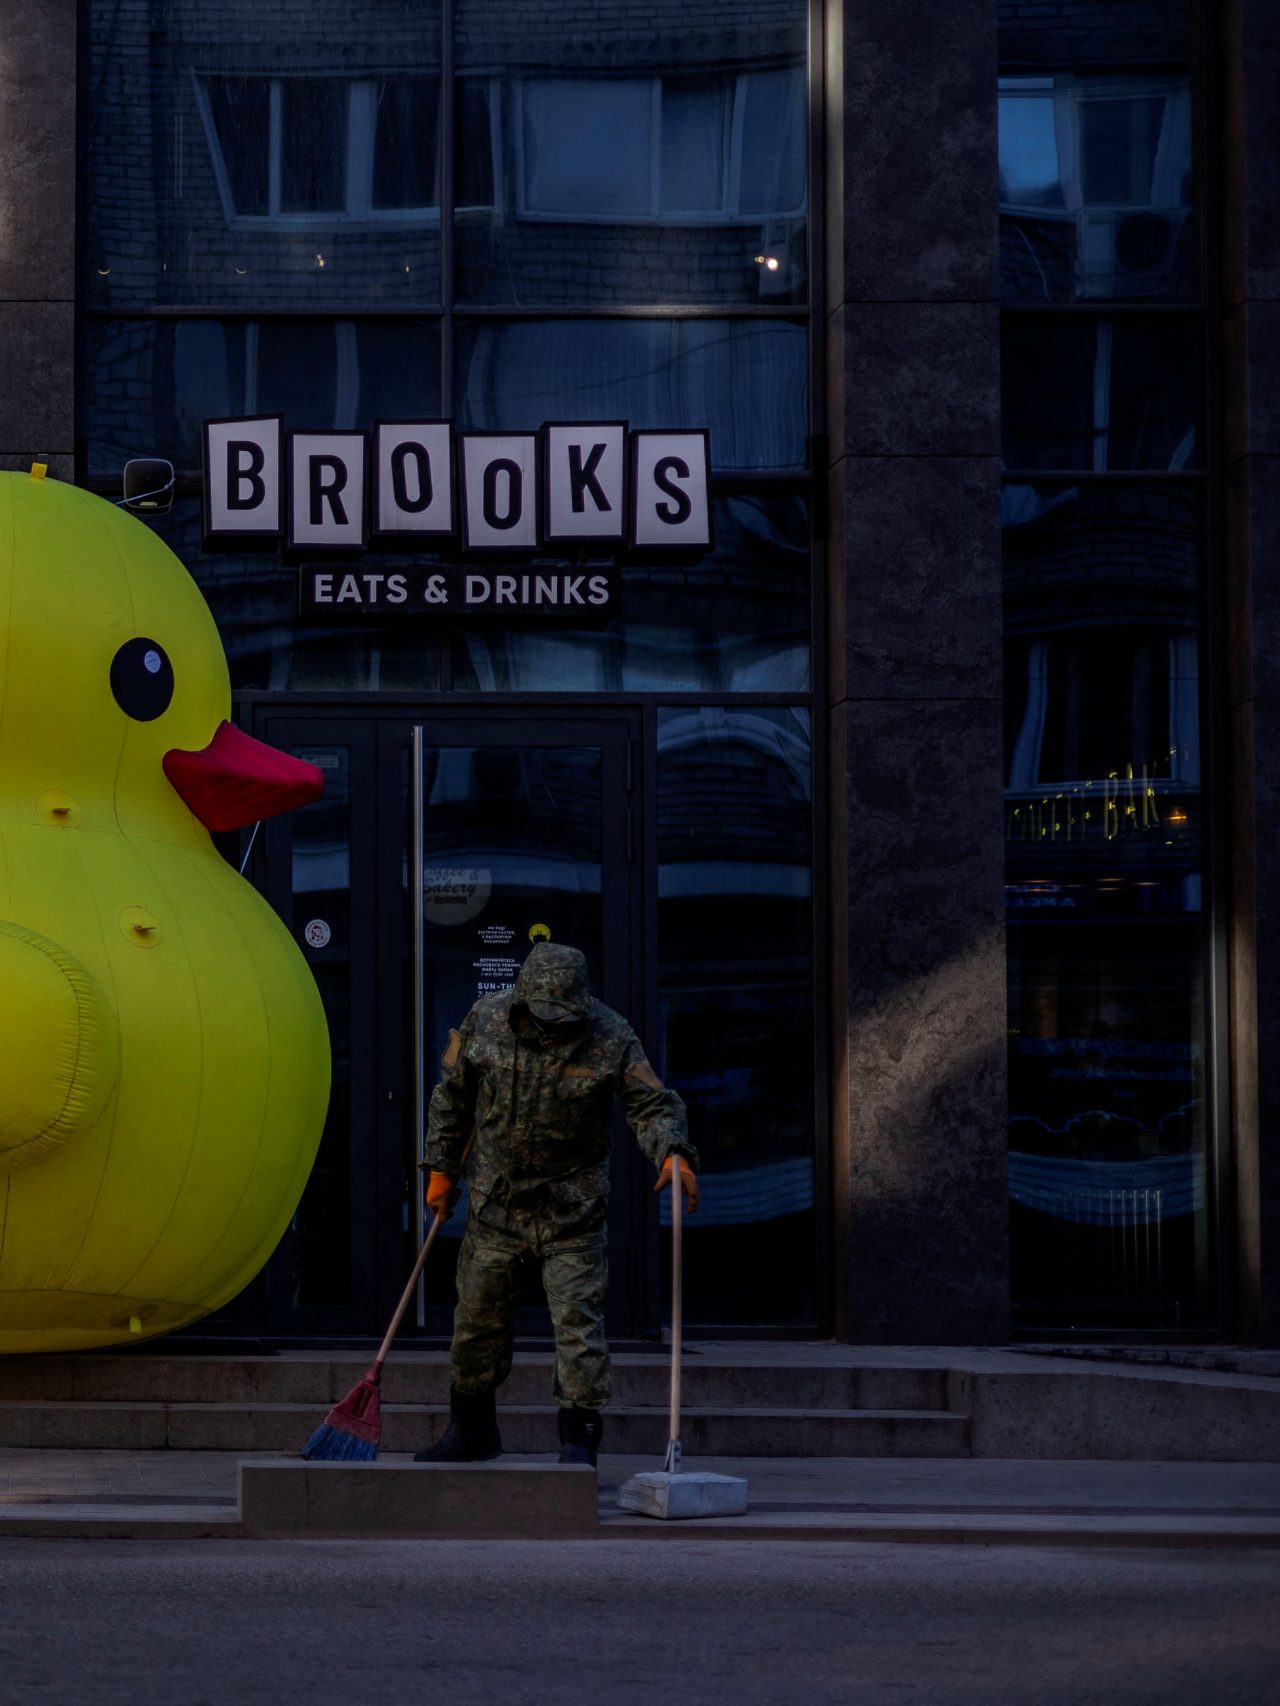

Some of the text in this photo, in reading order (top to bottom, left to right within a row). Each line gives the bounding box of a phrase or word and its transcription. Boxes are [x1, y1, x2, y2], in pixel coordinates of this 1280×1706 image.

[226, 440, 692, 531] BROOKS
[314, 574, 610, 605] EATS & DRINKS
